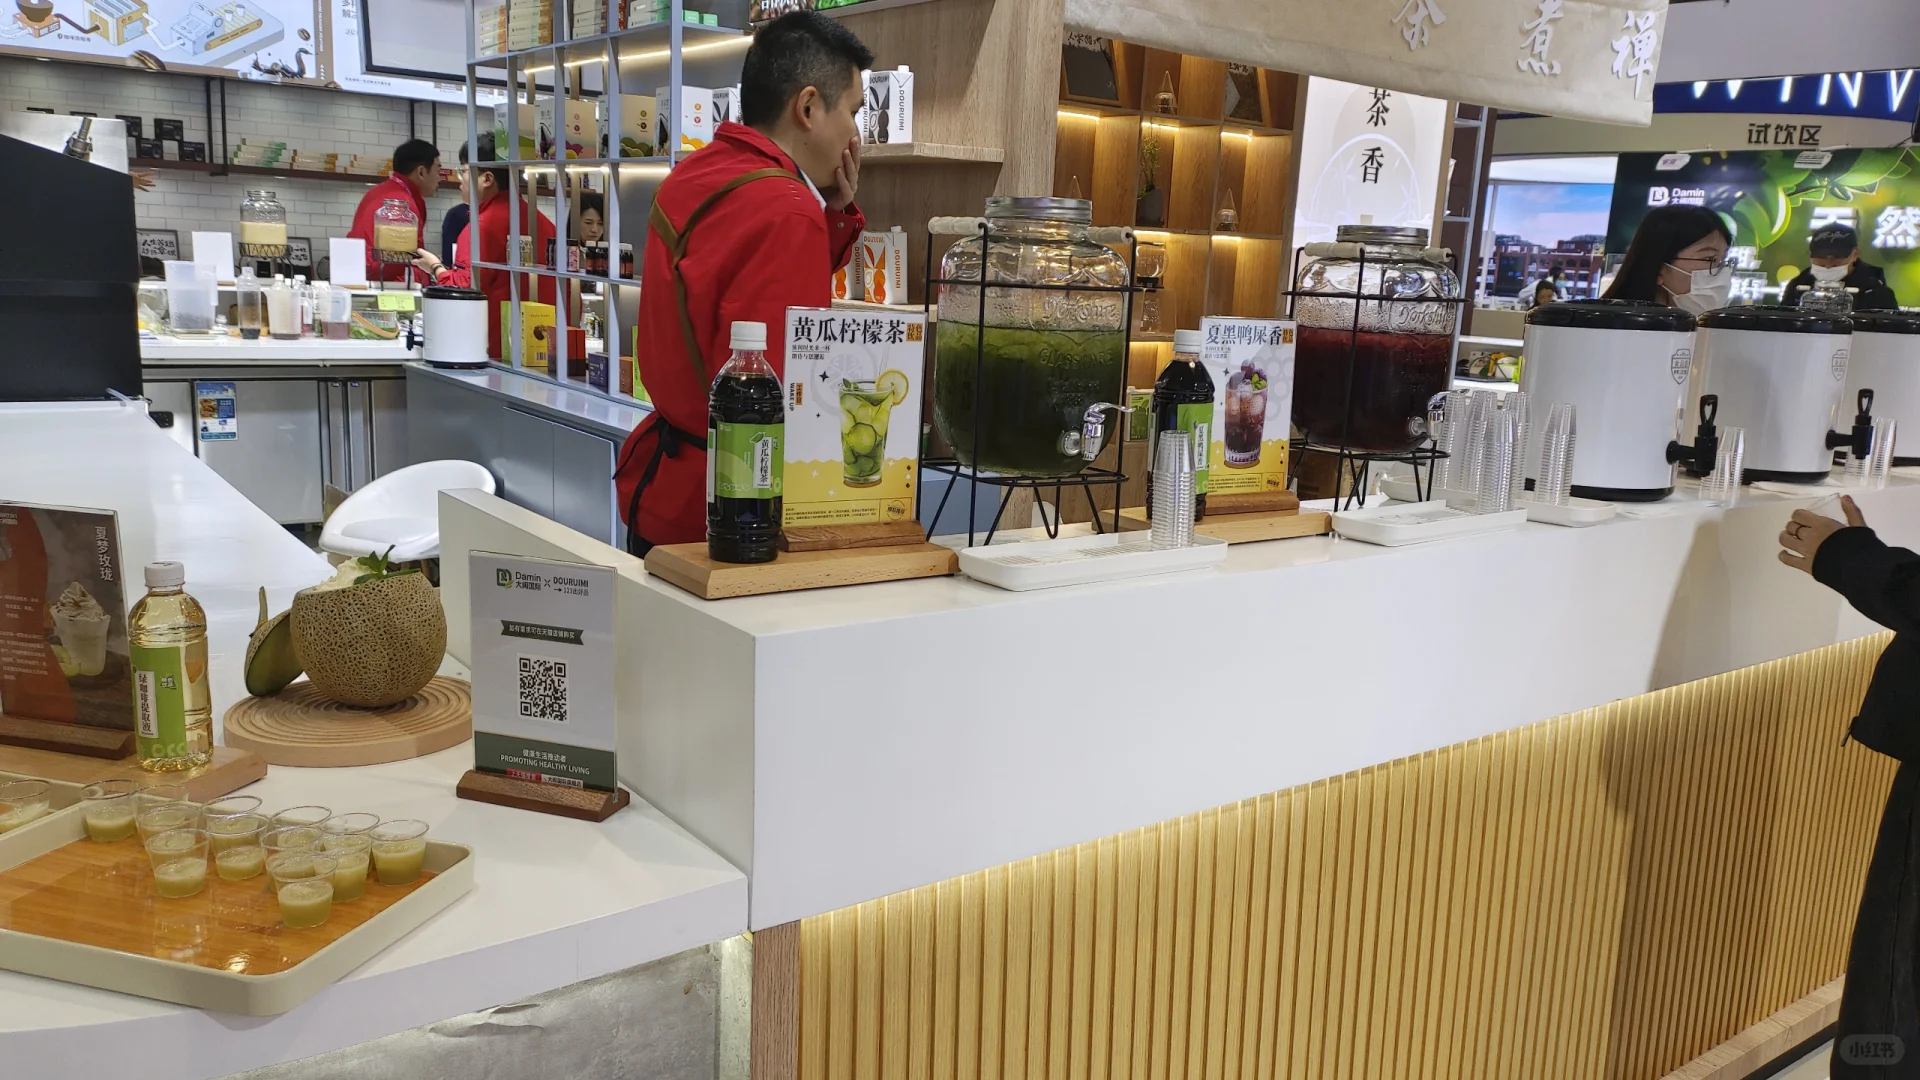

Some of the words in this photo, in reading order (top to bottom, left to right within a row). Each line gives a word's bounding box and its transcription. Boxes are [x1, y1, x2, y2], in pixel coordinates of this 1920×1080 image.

[1747, 123, 1822, 146] 试饮区
[1672, 188, 1705, 197] Damin
[792, 316, 905, 344] 黄瓜柠檬茶
[1206, 324, 1282, 346] 夏黑鸭屎香
[789, 402, 794, 411] UP
[760, 440, 770, 483] 黄瓜柠檬茶
[95, 526, 114, 581] 夏梦玫珑
[515, 572, 541, 582] Damin
[553, 576, 589, 588] DOURUIMI
[515, 581, 541, 591] 大闽国际
[138, 673, 151, 732] 绿咖啡提取液
[500, 754, 538, 767] PROMOTING
[539, 760, 568, 772] HEALTHY
[568, 765, 590, 775] LIVING
[522, 748, 567, 763] 健康生活推动者
